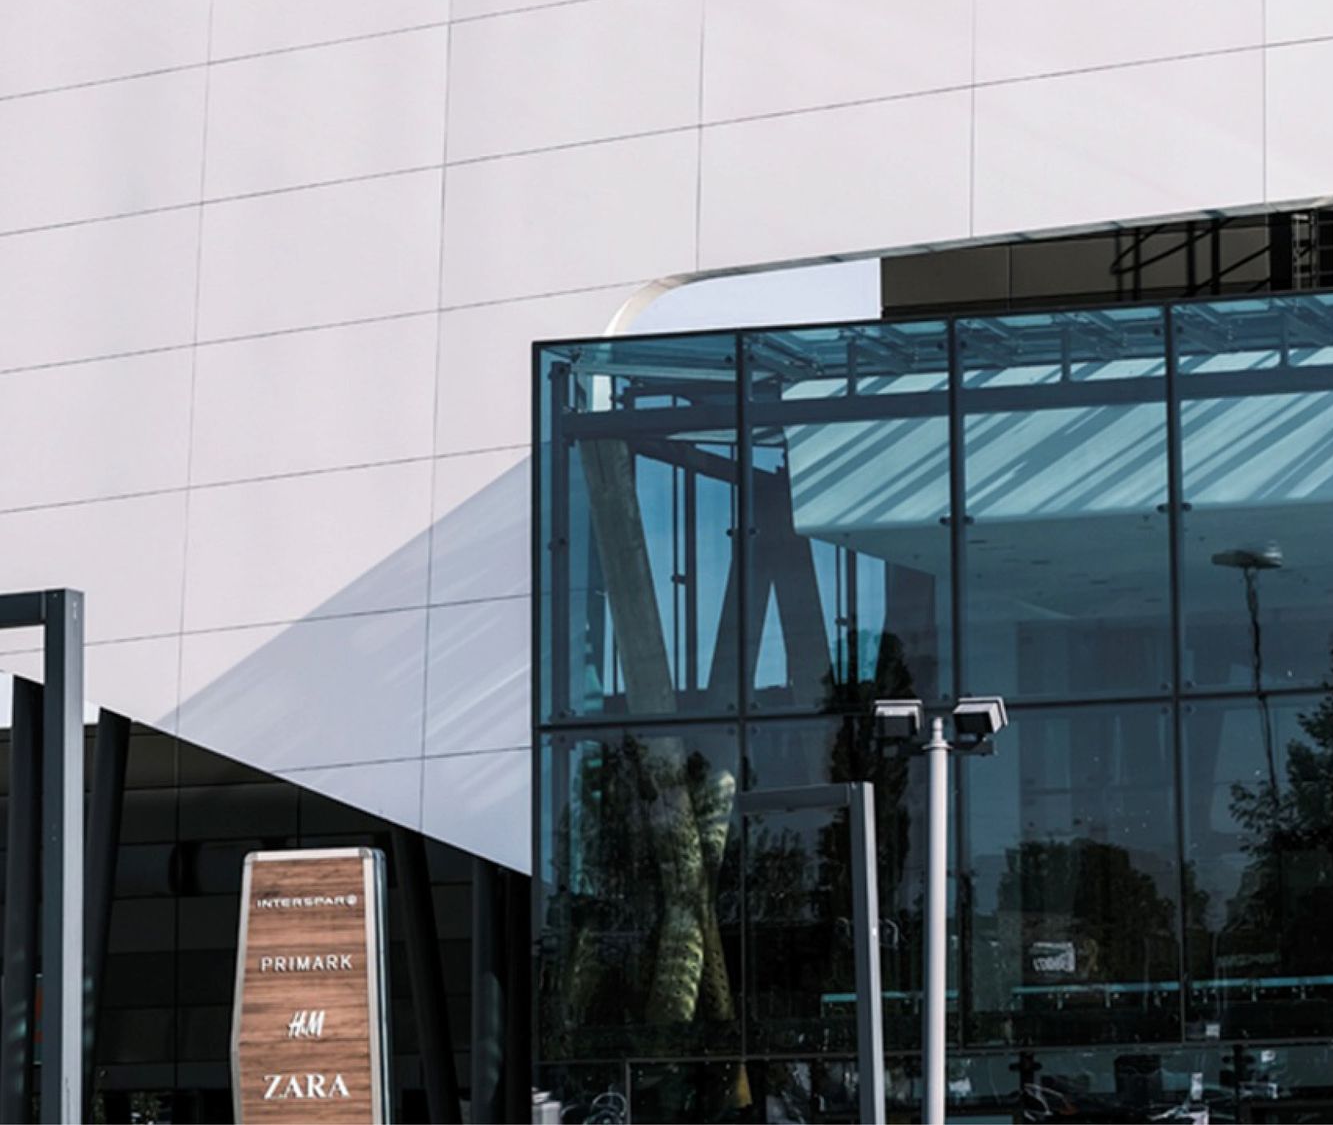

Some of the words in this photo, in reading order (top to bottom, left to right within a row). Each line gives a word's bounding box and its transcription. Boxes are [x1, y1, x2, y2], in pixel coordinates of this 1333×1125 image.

[257, 896, 345, 909] INTERSPAR
[261, 954, 353, 972] PRIMARK
[263, 1073, 352, 1099] ZARA
